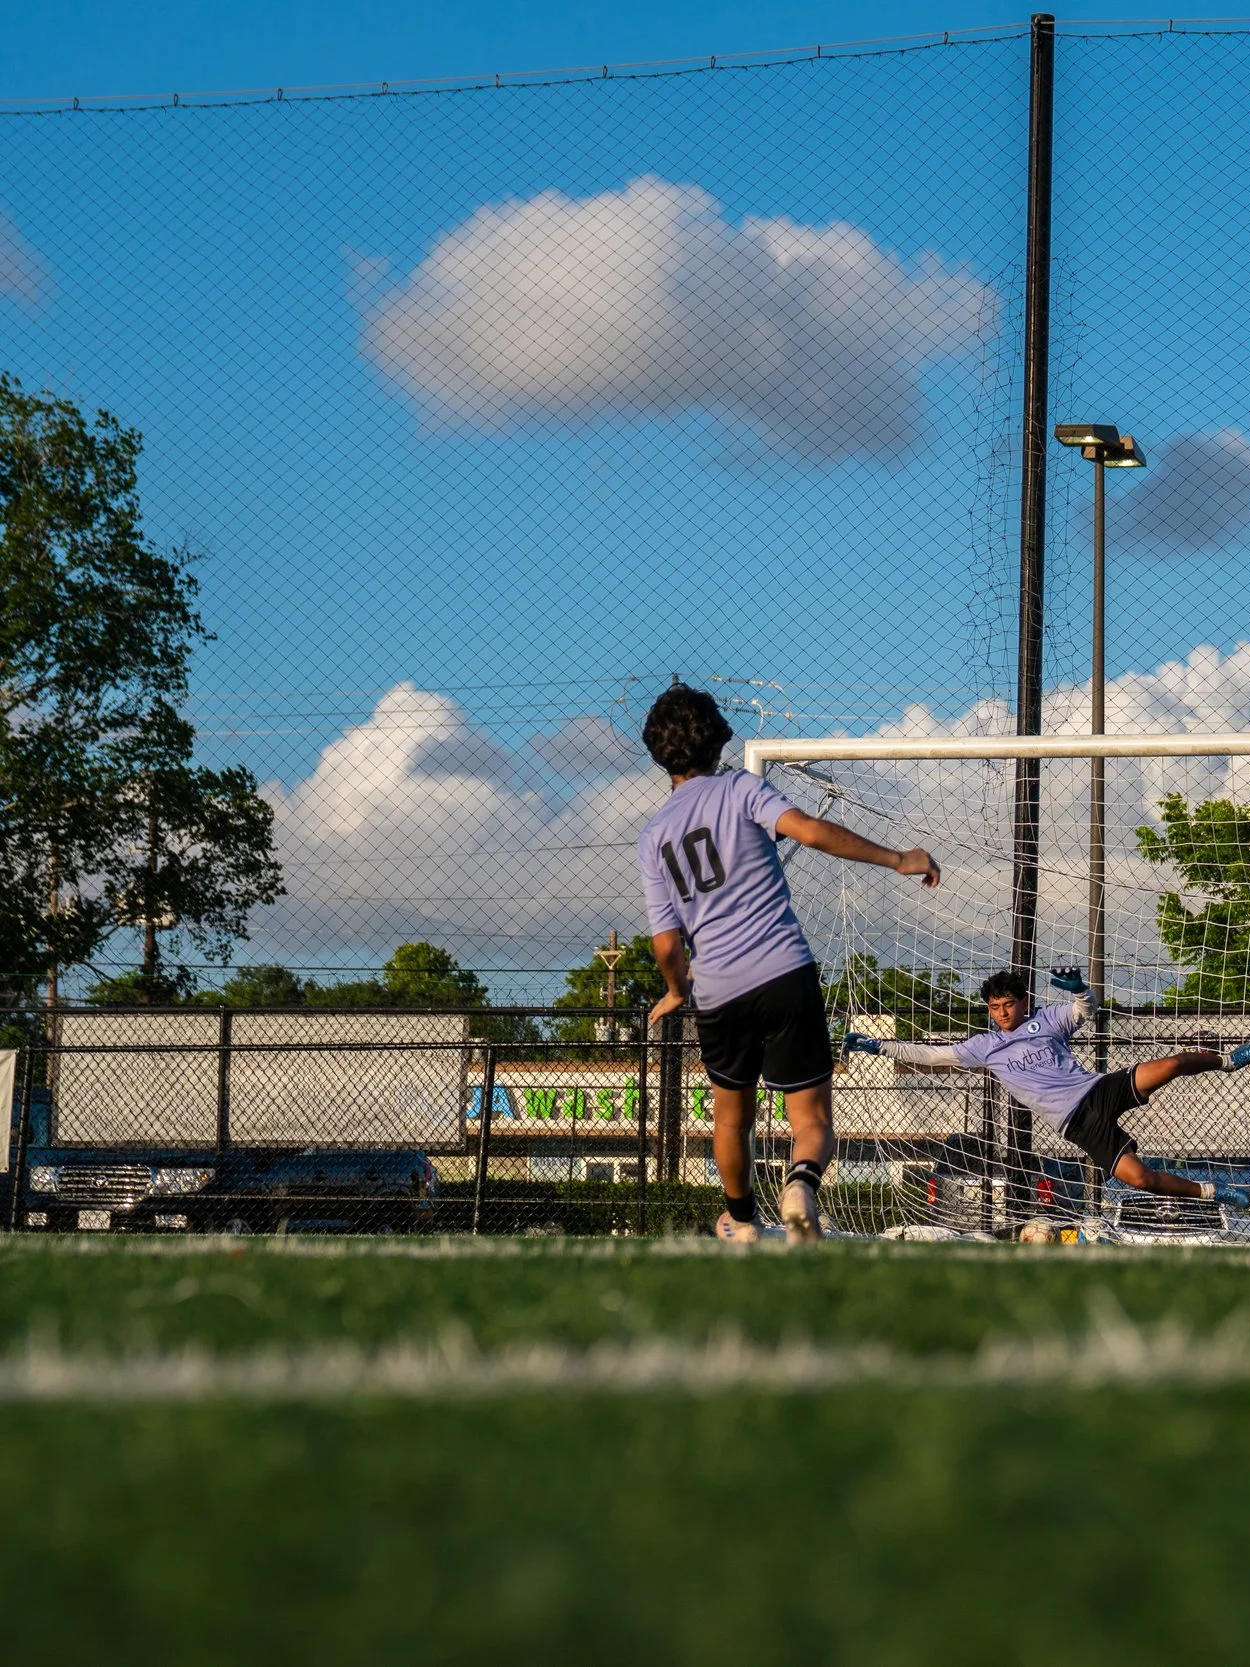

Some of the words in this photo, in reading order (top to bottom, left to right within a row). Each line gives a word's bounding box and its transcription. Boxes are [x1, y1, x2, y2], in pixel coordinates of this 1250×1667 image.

[661, 827, 726, 903] 10
[1006, 1046, 1055, 1073] rhythm
[1030, 1058, 1056, 1071] energy
